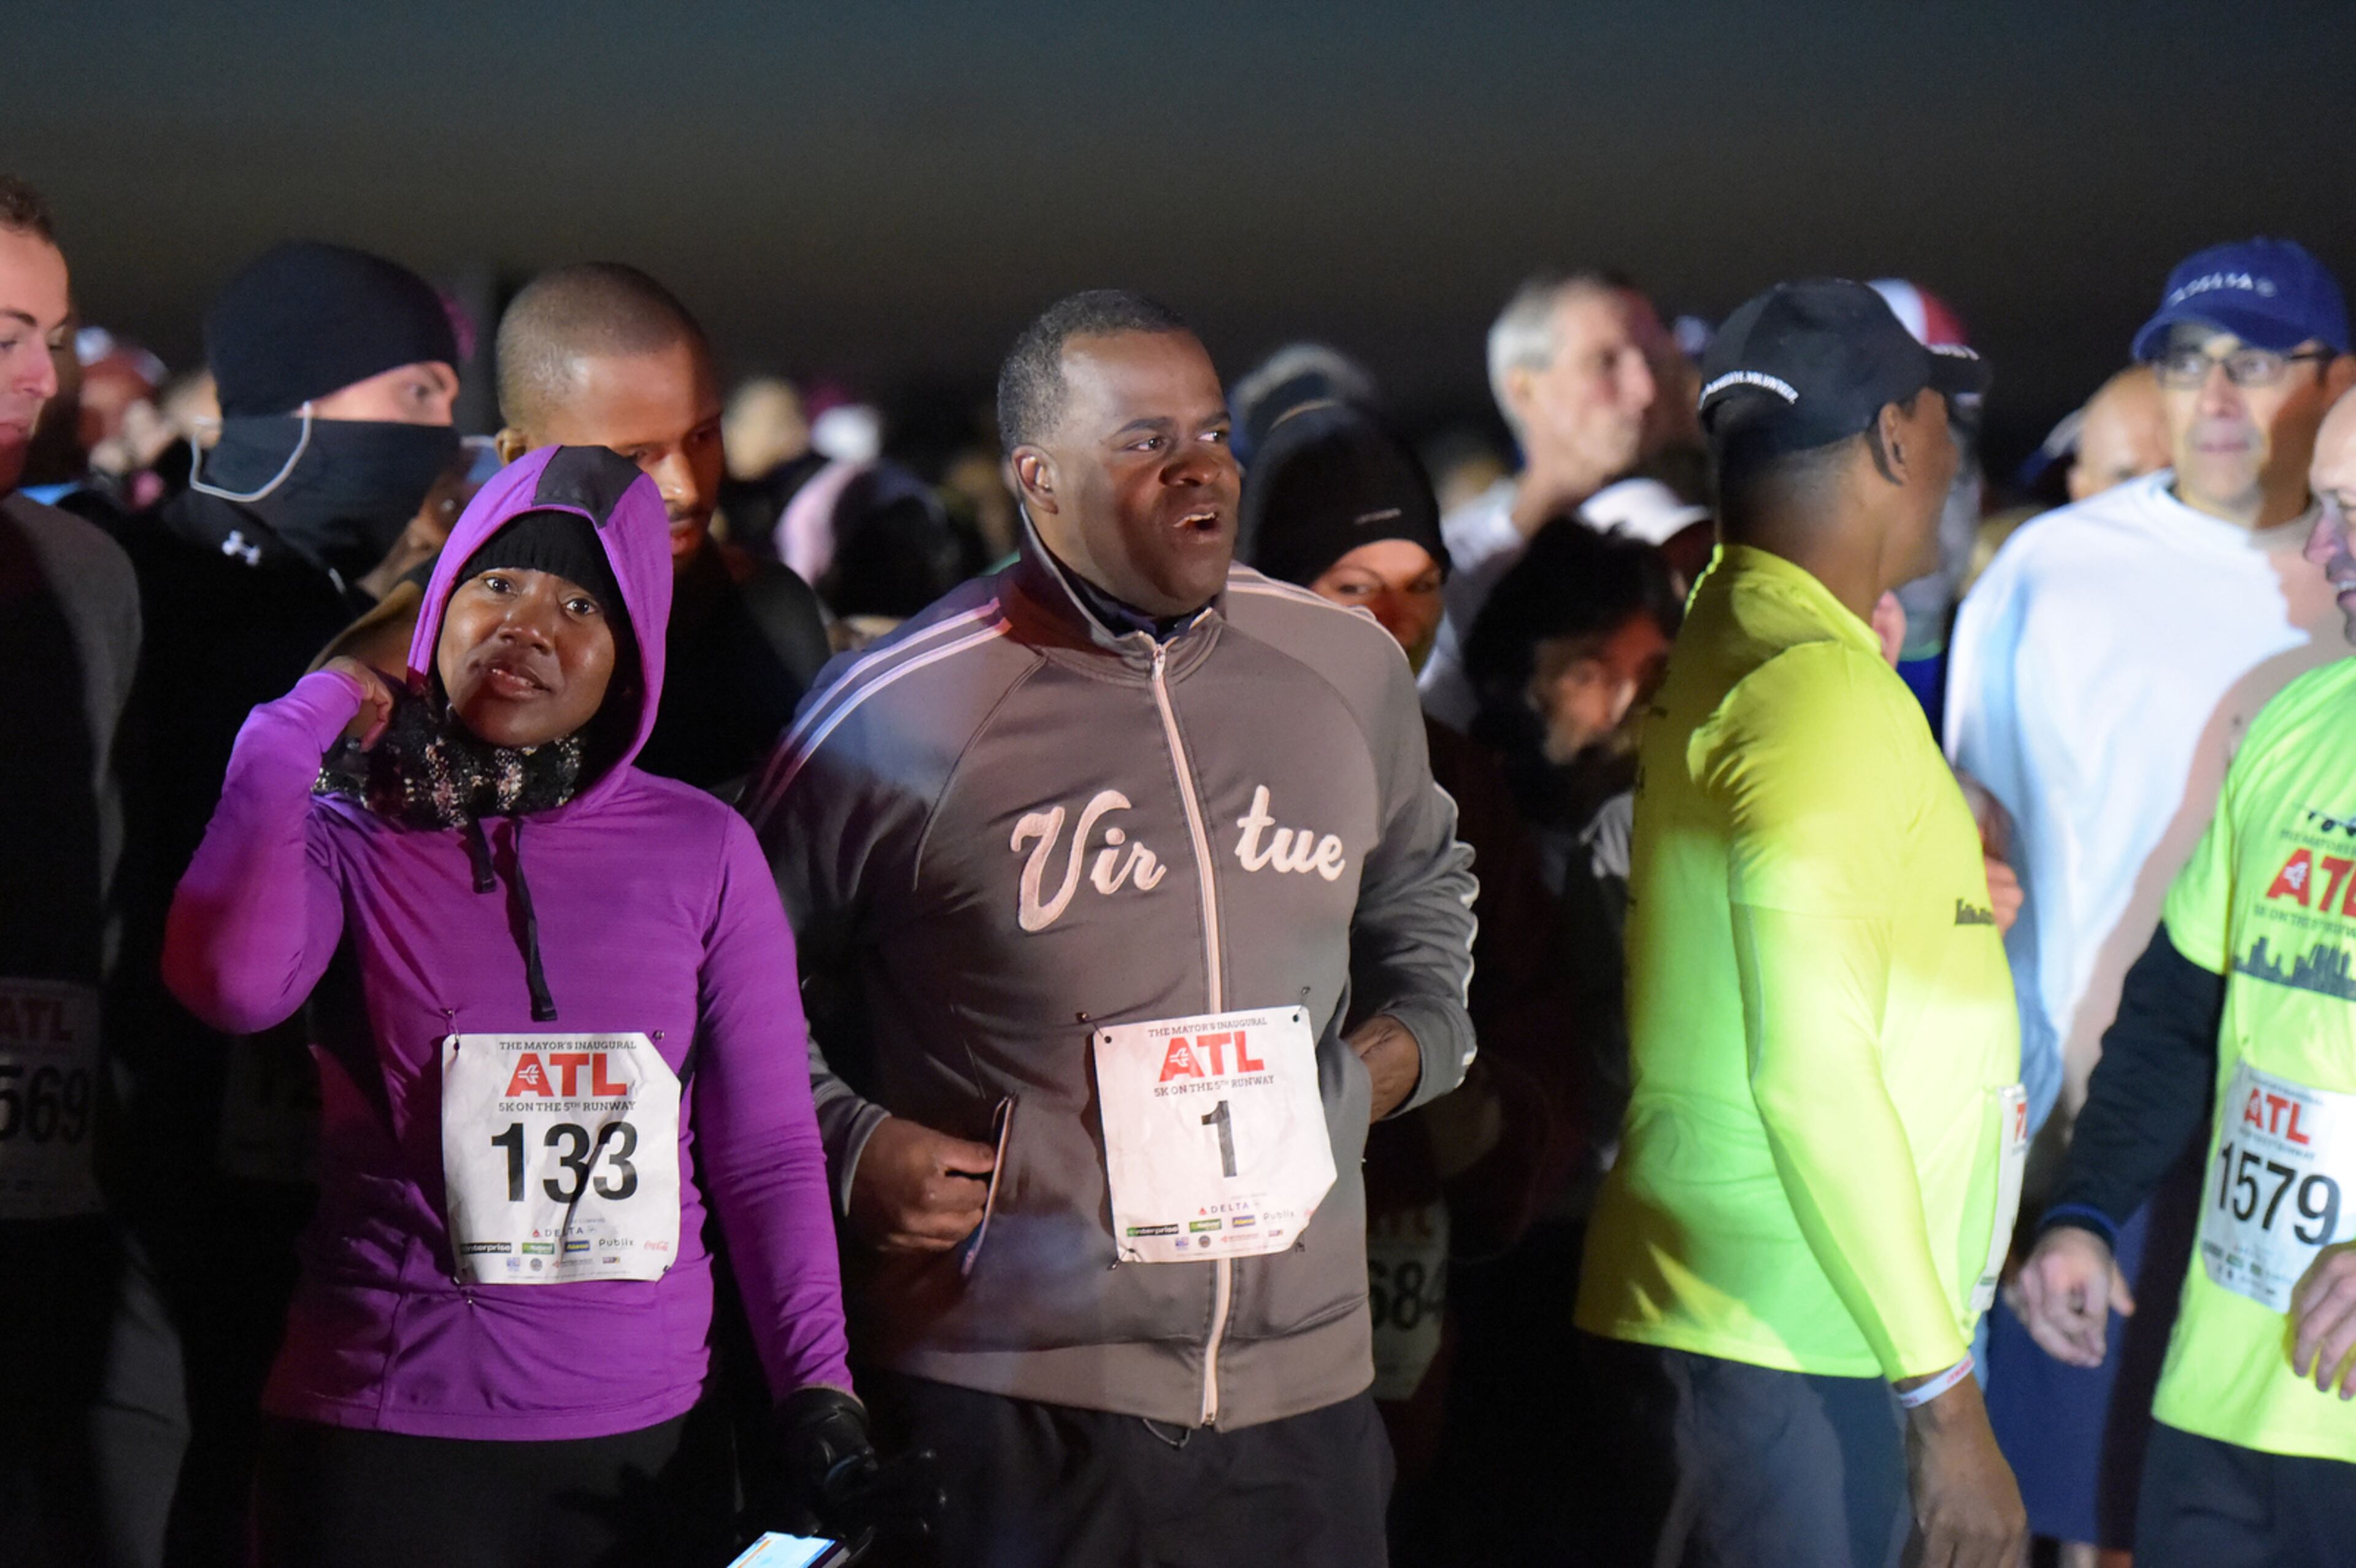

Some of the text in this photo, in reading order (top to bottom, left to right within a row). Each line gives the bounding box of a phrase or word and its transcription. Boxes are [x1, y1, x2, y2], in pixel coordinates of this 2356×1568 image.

[1010, 785, 1345, 931] Vir tue
[524, 1042, 573, 1050] MAYOR'S
[575, 1040, 636, 1050] INAUGURAL
[1148, 1017, 1267, 1037] THE MAYOR'S INAUGURAL
[505, 1053, 627, 1097] ATL
[1159, 1031, 1264, 1082] ATL
[499, 1102, 514, 1112] 5K
[516, 1102, 533, 1112] ON
[535, 1102, 561, 1112] THE
[583, 1101, 636, 1112] RUNWAY
[1154, 1087, 1169, 1097] 5K
[1171, 1085, 1187, 1094] ON
[1188, 1082, 1213, 1093] THE
[1231, 1075, 1274, 1088] RUNWAY
[1201, 1100, 1238, 1178] 1
[2244, 1088, 2311, 1145] ATL
[491, 1121, 638, 1203] 133
[1211, 1202, 1249, 1213] DELTA
[2219, 1142, 2341, 1246] 1579
